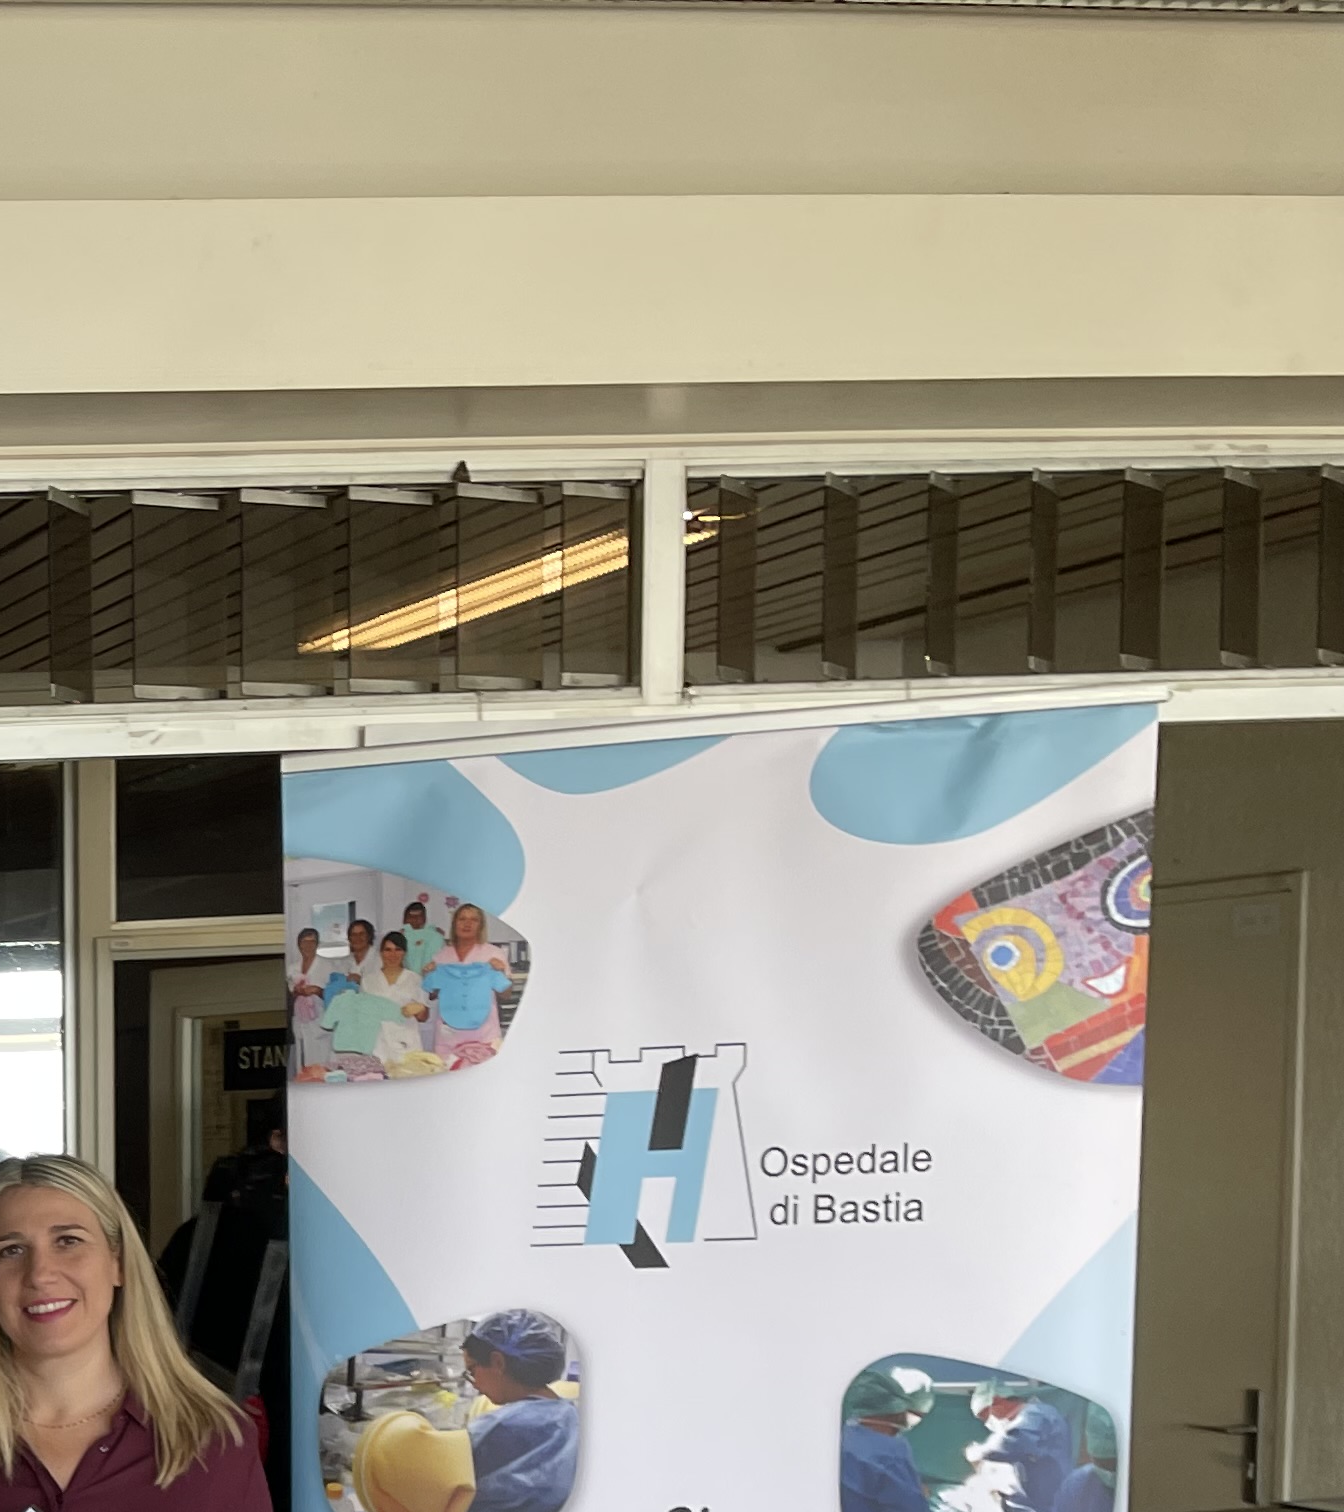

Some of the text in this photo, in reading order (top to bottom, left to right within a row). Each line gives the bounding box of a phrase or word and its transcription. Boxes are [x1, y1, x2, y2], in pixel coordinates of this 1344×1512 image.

[760, 1142, 933, 1184] Ospedale
[769, 1191, 924, 1226] di Bastia
